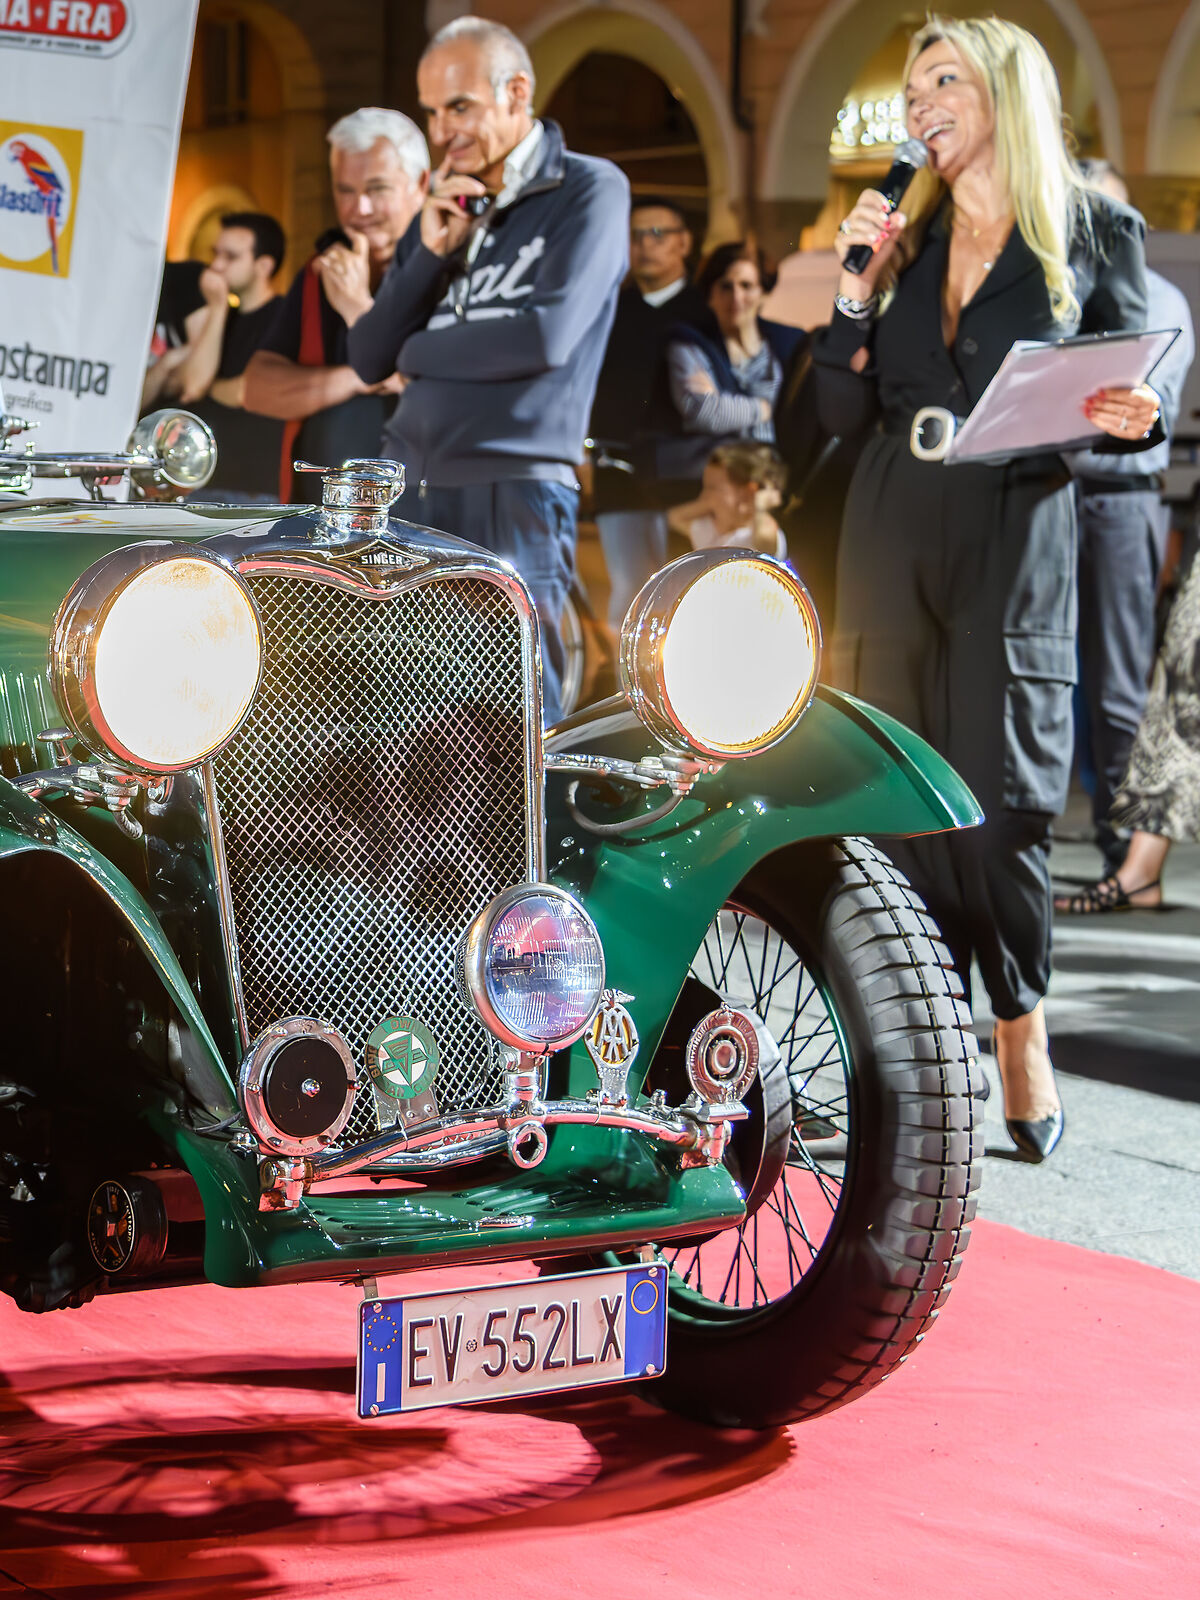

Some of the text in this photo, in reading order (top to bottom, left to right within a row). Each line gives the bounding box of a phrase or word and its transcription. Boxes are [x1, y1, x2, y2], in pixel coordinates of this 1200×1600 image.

[361, 553, 404, 565] SINGER
[408, 1292, 624, 1388] EV 552LX
